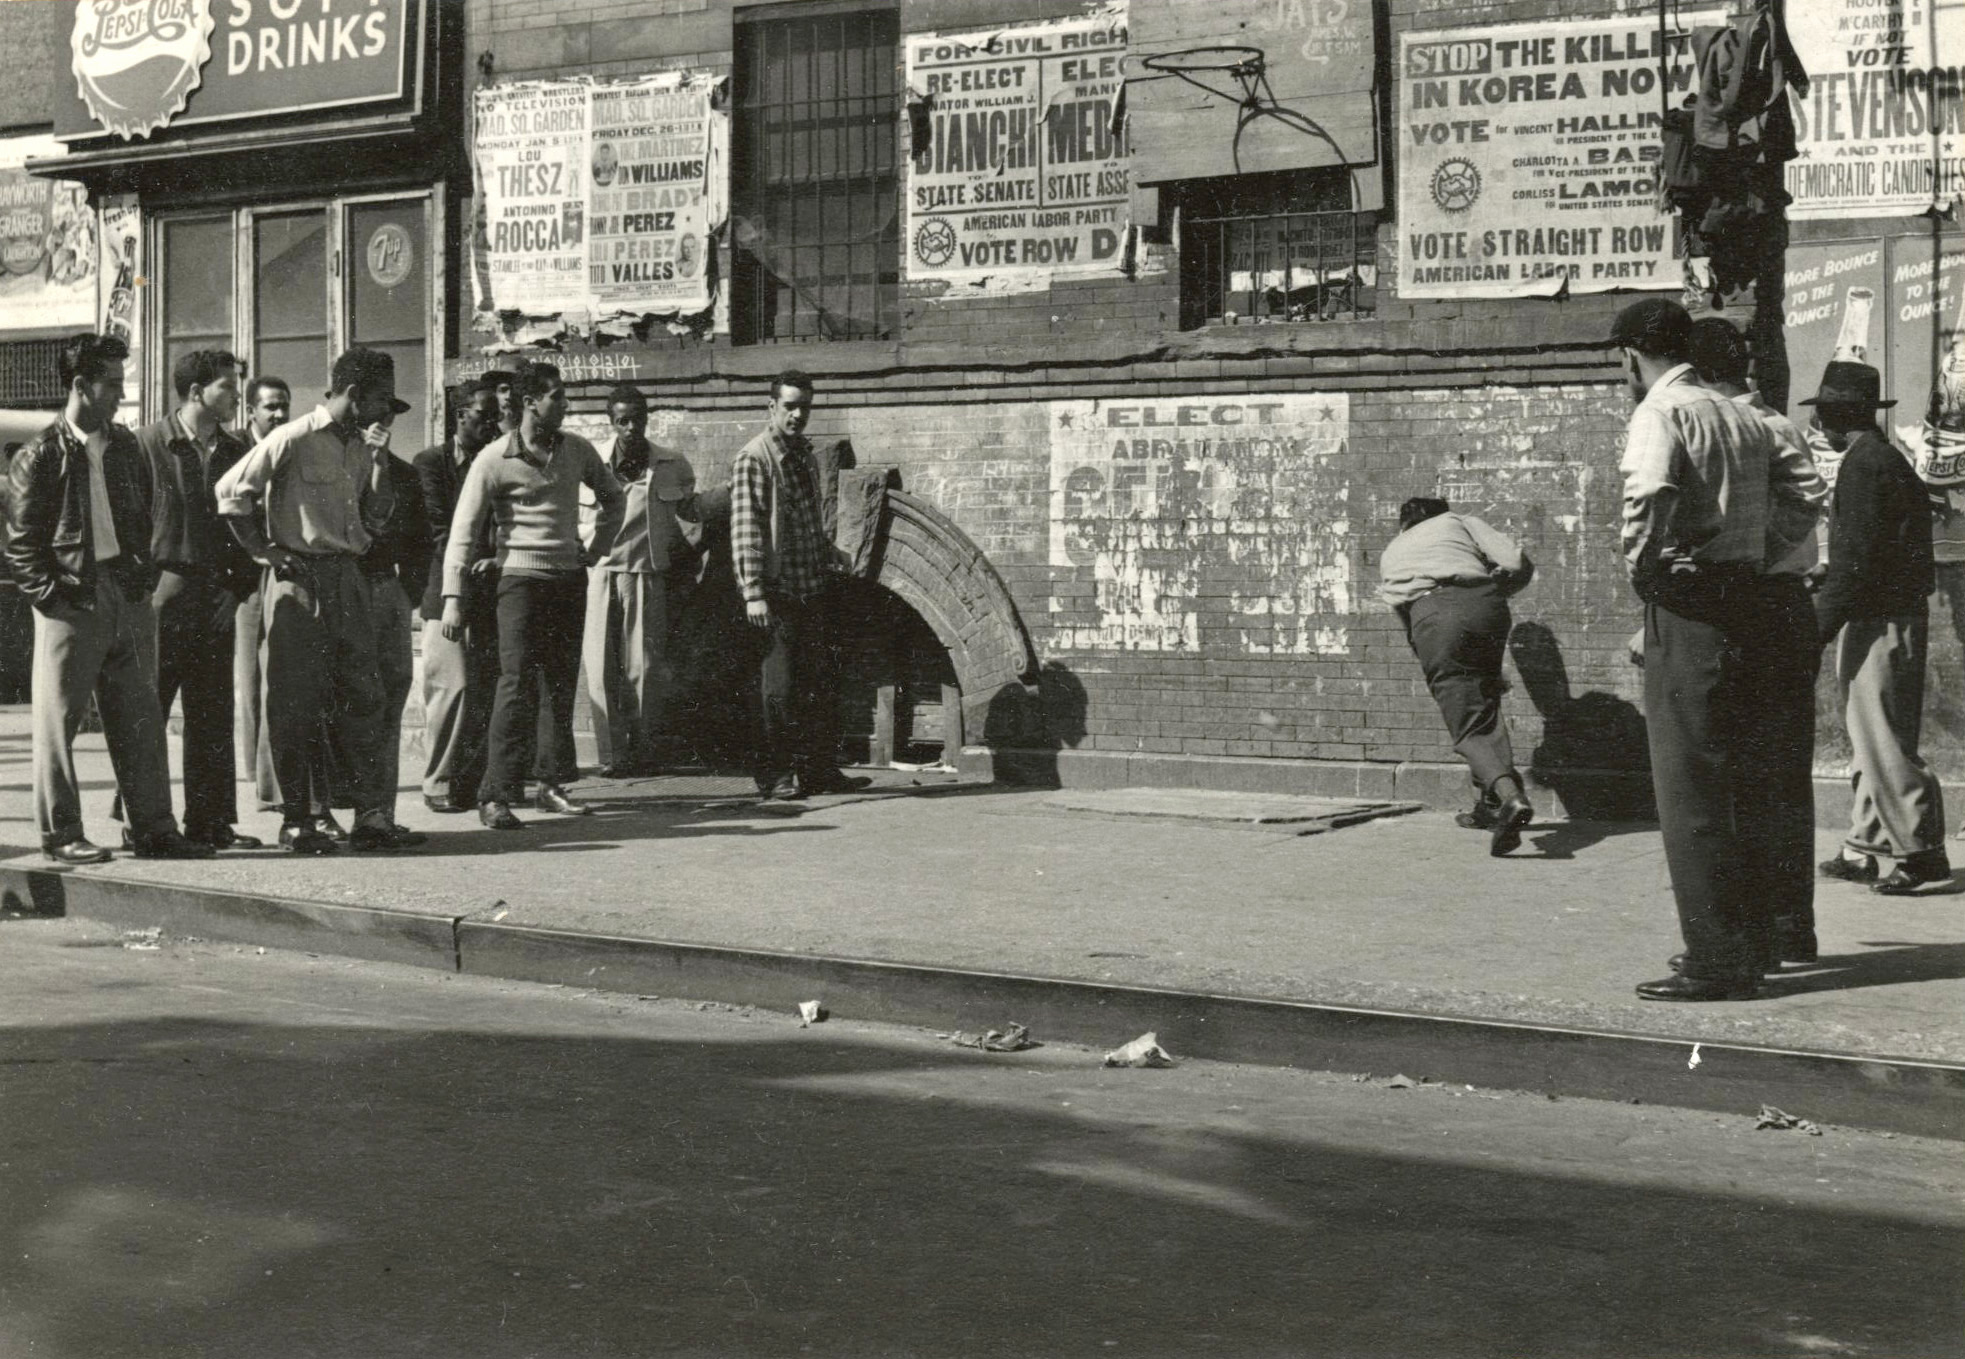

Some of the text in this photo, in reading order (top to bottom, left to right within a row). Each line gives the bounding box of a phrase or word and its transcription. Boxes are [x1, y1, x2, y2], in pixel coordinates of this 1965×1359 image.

[228, 11, 386, 76] DRINKS
[918, 29, 1127, 63] FOR CIVIL RIGH
[1852, 30, 1909, 46] IF NOT
[1409, 28, 1689, 75] STOP THE KILLIN
[1847, 46, 1914, 68] VOTE
[927, 66, 1026, 93] RE-ELECT
[1062, 56, 1127, 82] ELEC
[1412, 63, 1695, 109] IN KOREA NOW
[505, 96, 586, 111] TELEVISION
[652, 95, 704, 120] GARDEN
[930, 95, 1036, 111] NATOR WILLIAM J.
[510, 113, 532, 135] SQ.
[533, 109, 585, 133] GARDEN
[1410, 112, 1664, 146] VOTE for VINCENT HALLIN
[477, 140, 520, 150] MONDAY
[592, 129, 629, 139] FRIDAY
[1567, 135, 1612, 144] PRESIDENT
[1617, 133, 1626, 141] OF
[1632, 132, 1646, 140] THE
[518, 150, 541, 162] LOU
[639, 137, 704, 159] MARTINEZ
[1512, 155, 1569, 168] CHARLOTTA
[1588, 145, 1663, 165] BAS
[1834, 143, 1926, 157] AND THE
[497, 162, 563, 198] THESZ
[631, 161, 703, 184] WILLIAMS
[1617, 167, 1627, 175] OF
[1632, 165, 1646, 174] THE
[1788, 161, 1875, 199] DEMOCRATIC
[917, 179, 1035, 207] STATE SENATE
[1049, 169, 1129, 200] STATE ASSE
[1512, 179, 1655, 199] CORLISS LAMO
[627, 187, 700, 210] BRADY
[1559, 201, 1588, 210] UNITED
[1592, 200, 1623, 209] STATES
[1627, 198, 1653, 207] SENAT
[503, 204, 556, 217] ANTONINO
[623, 211, 675, 233] PEREZ
[963, 207, 1117, 231] AMERICAN LABOR PARTY
[494, 218, 560, 253] ROCCA
[960, 228, 1118, 266] VOTE ROW D
[1410, 232, 1467, 260] VOTE
[1482, 227, 1602, 257] STRAIGHT
[1612, 225, 1665, 254] ROW
[615, 239, 676, 260] PEREZ
[612, 261, 673, 283] VALLES
[1413, 260, 1657, 284] AMERICAN LABOR PARTY
[1785, 251, 1879, 288] MORE BOUNCE
[1894, 260, 1934, 283] MORE
[1791, 283, 1835, 307] TO THE
[1906, 285, 1923, 300] TO
[1786, 302, 1838, 328] OUNCE!
[1107, 403, 1285, 428] ELECT
